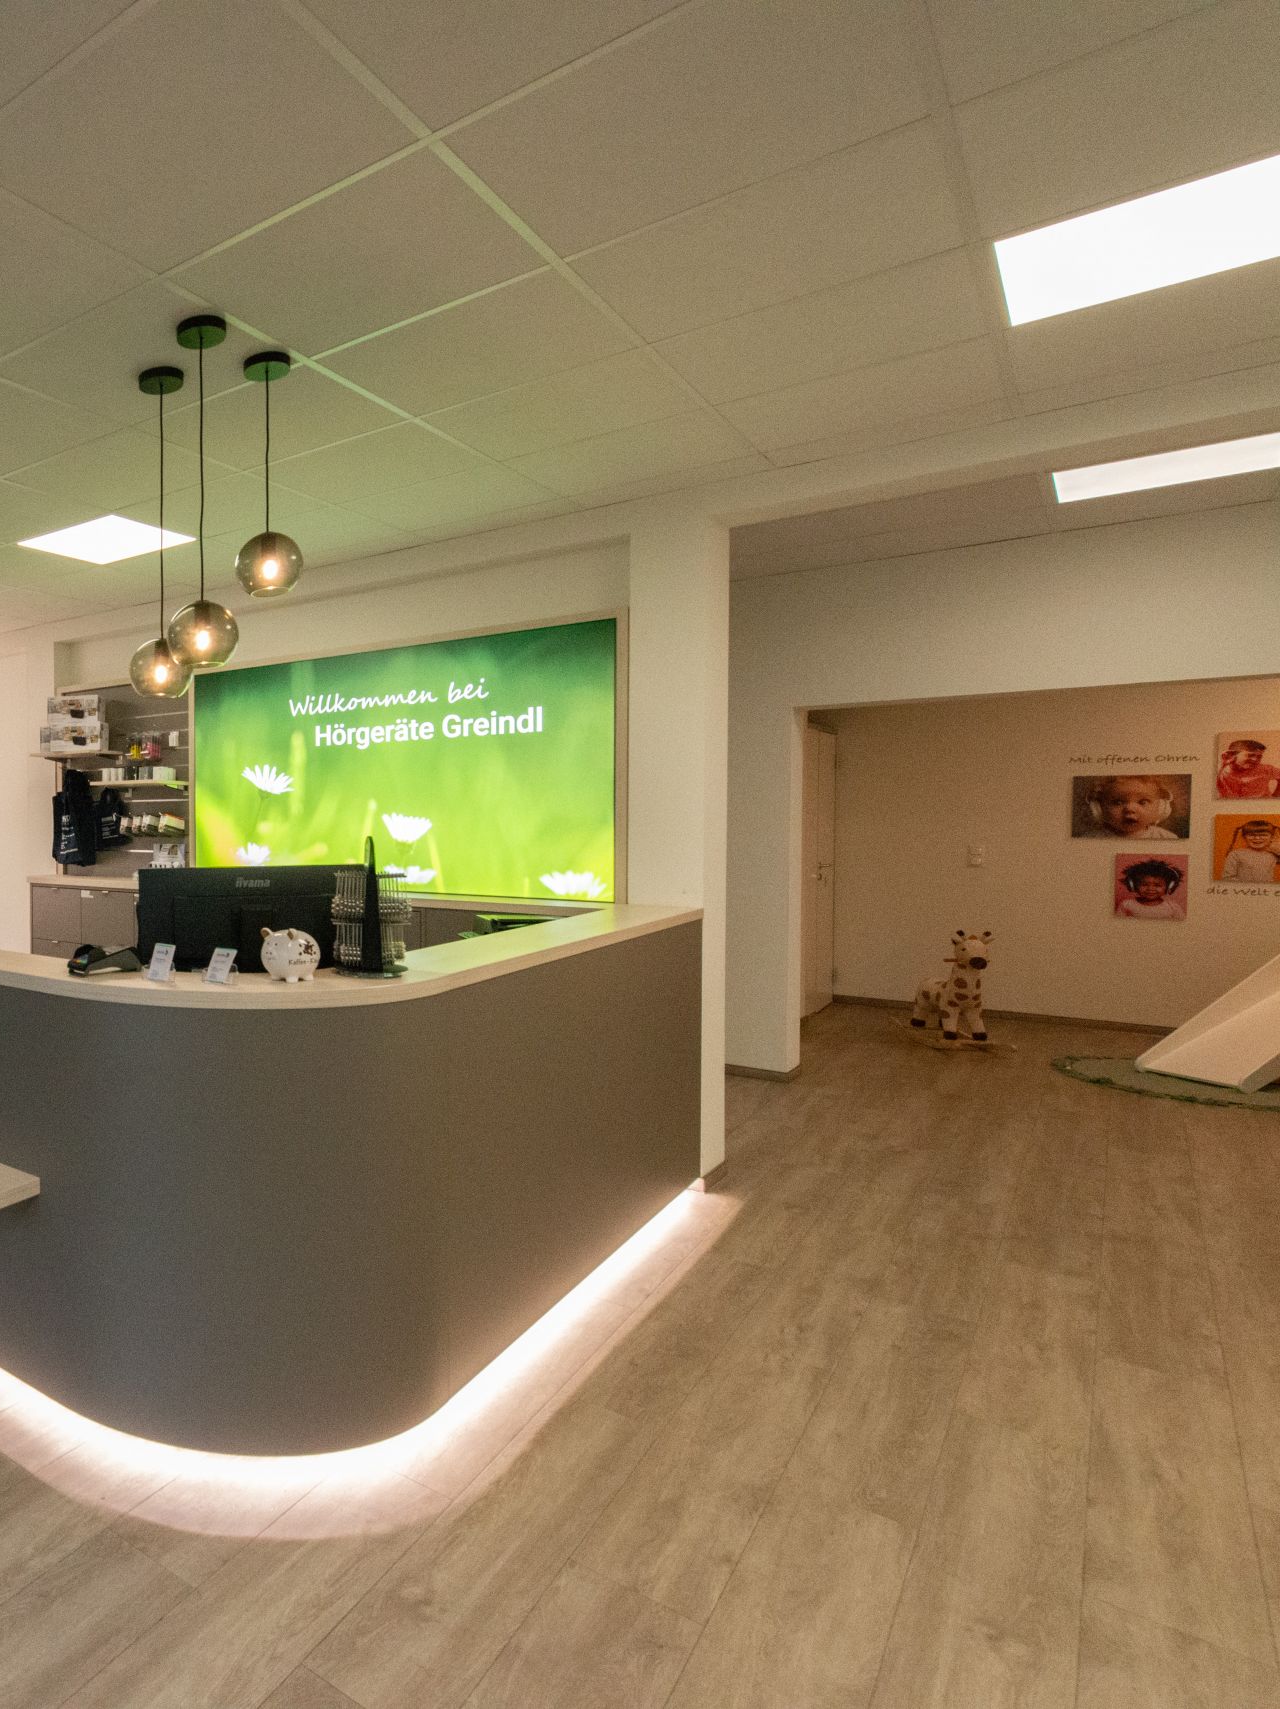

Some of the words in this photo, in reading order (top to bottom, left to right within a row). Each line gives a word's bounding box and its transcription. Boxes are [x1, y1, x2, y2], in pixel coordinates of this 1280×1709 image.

[289, 686, 438, 717] Willkommen
[448, 677, 489, 704] bei
[314, 718, 434, 750] Hörgeräte
[442, 706, 544, 738] Greindl
[1096, 754, 1150, 766] offenen
[1154, 754, 1200, 763] Ohren
[1206, 885, 1228, 896] die
